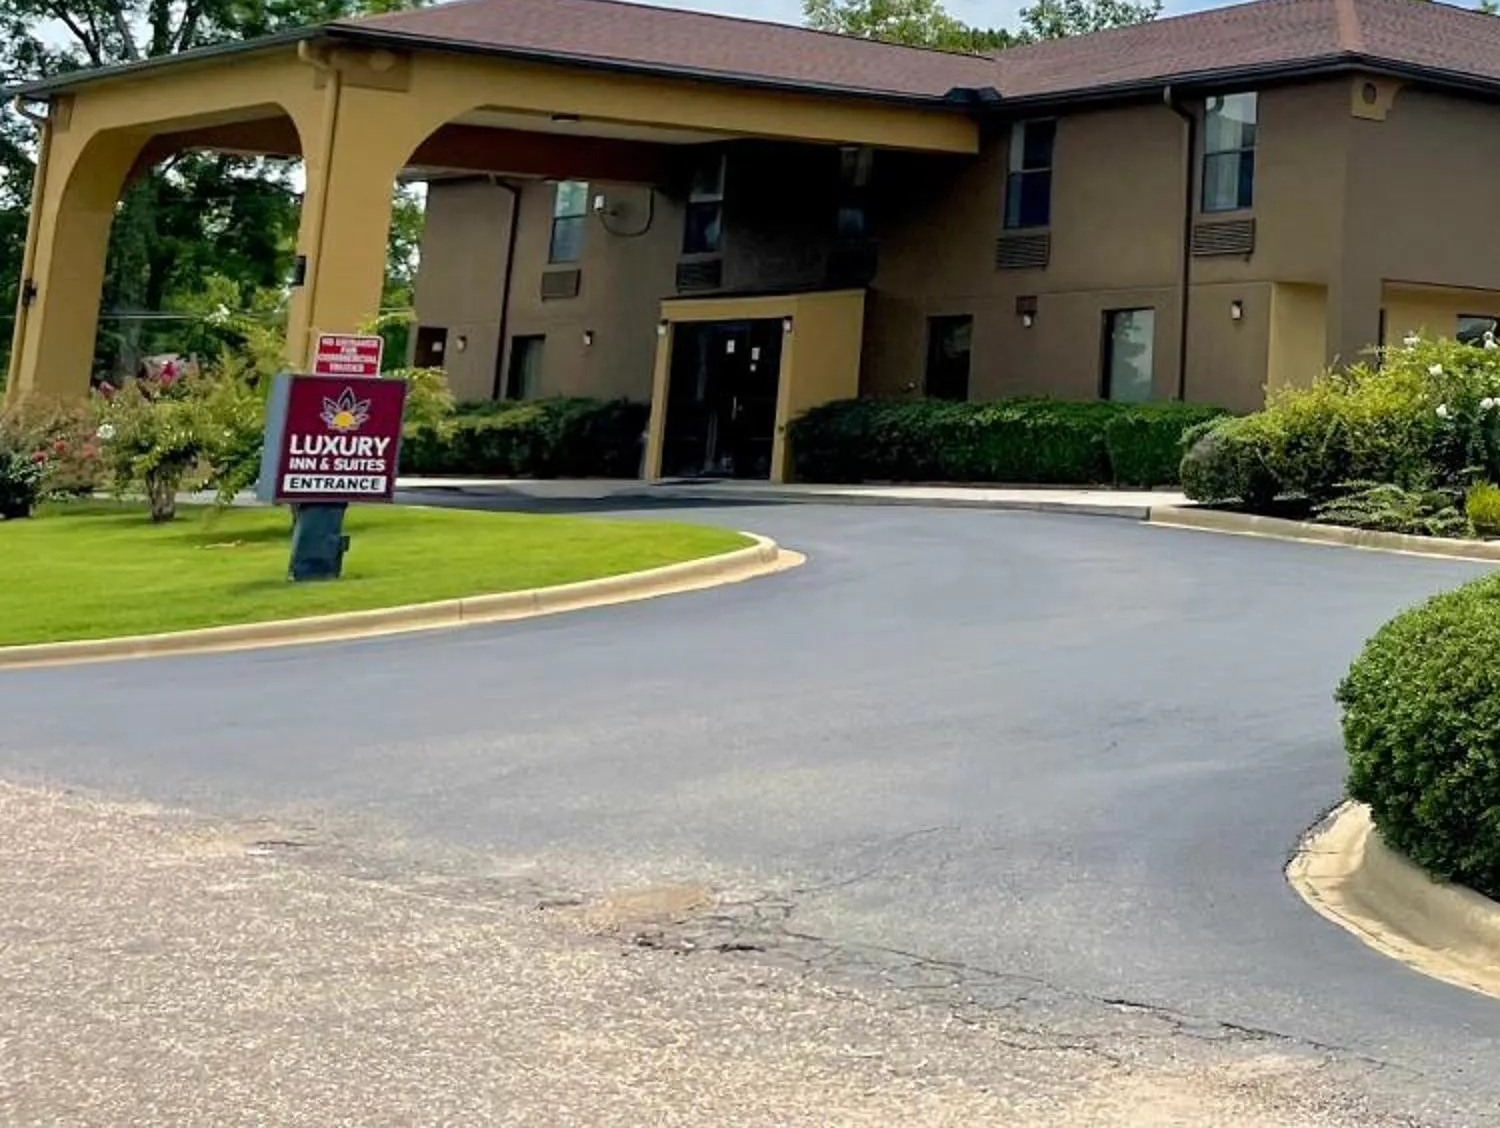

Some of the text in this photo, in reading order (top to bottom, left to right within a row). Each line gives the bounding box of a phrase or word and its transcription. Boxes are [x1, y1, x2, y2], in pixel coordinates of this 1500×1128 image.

[289, 434, 391, 457] LUXURY
[289, 457, 386, 472] INN & SUITES
[289, 477, 380, 491] ENTRANCE
